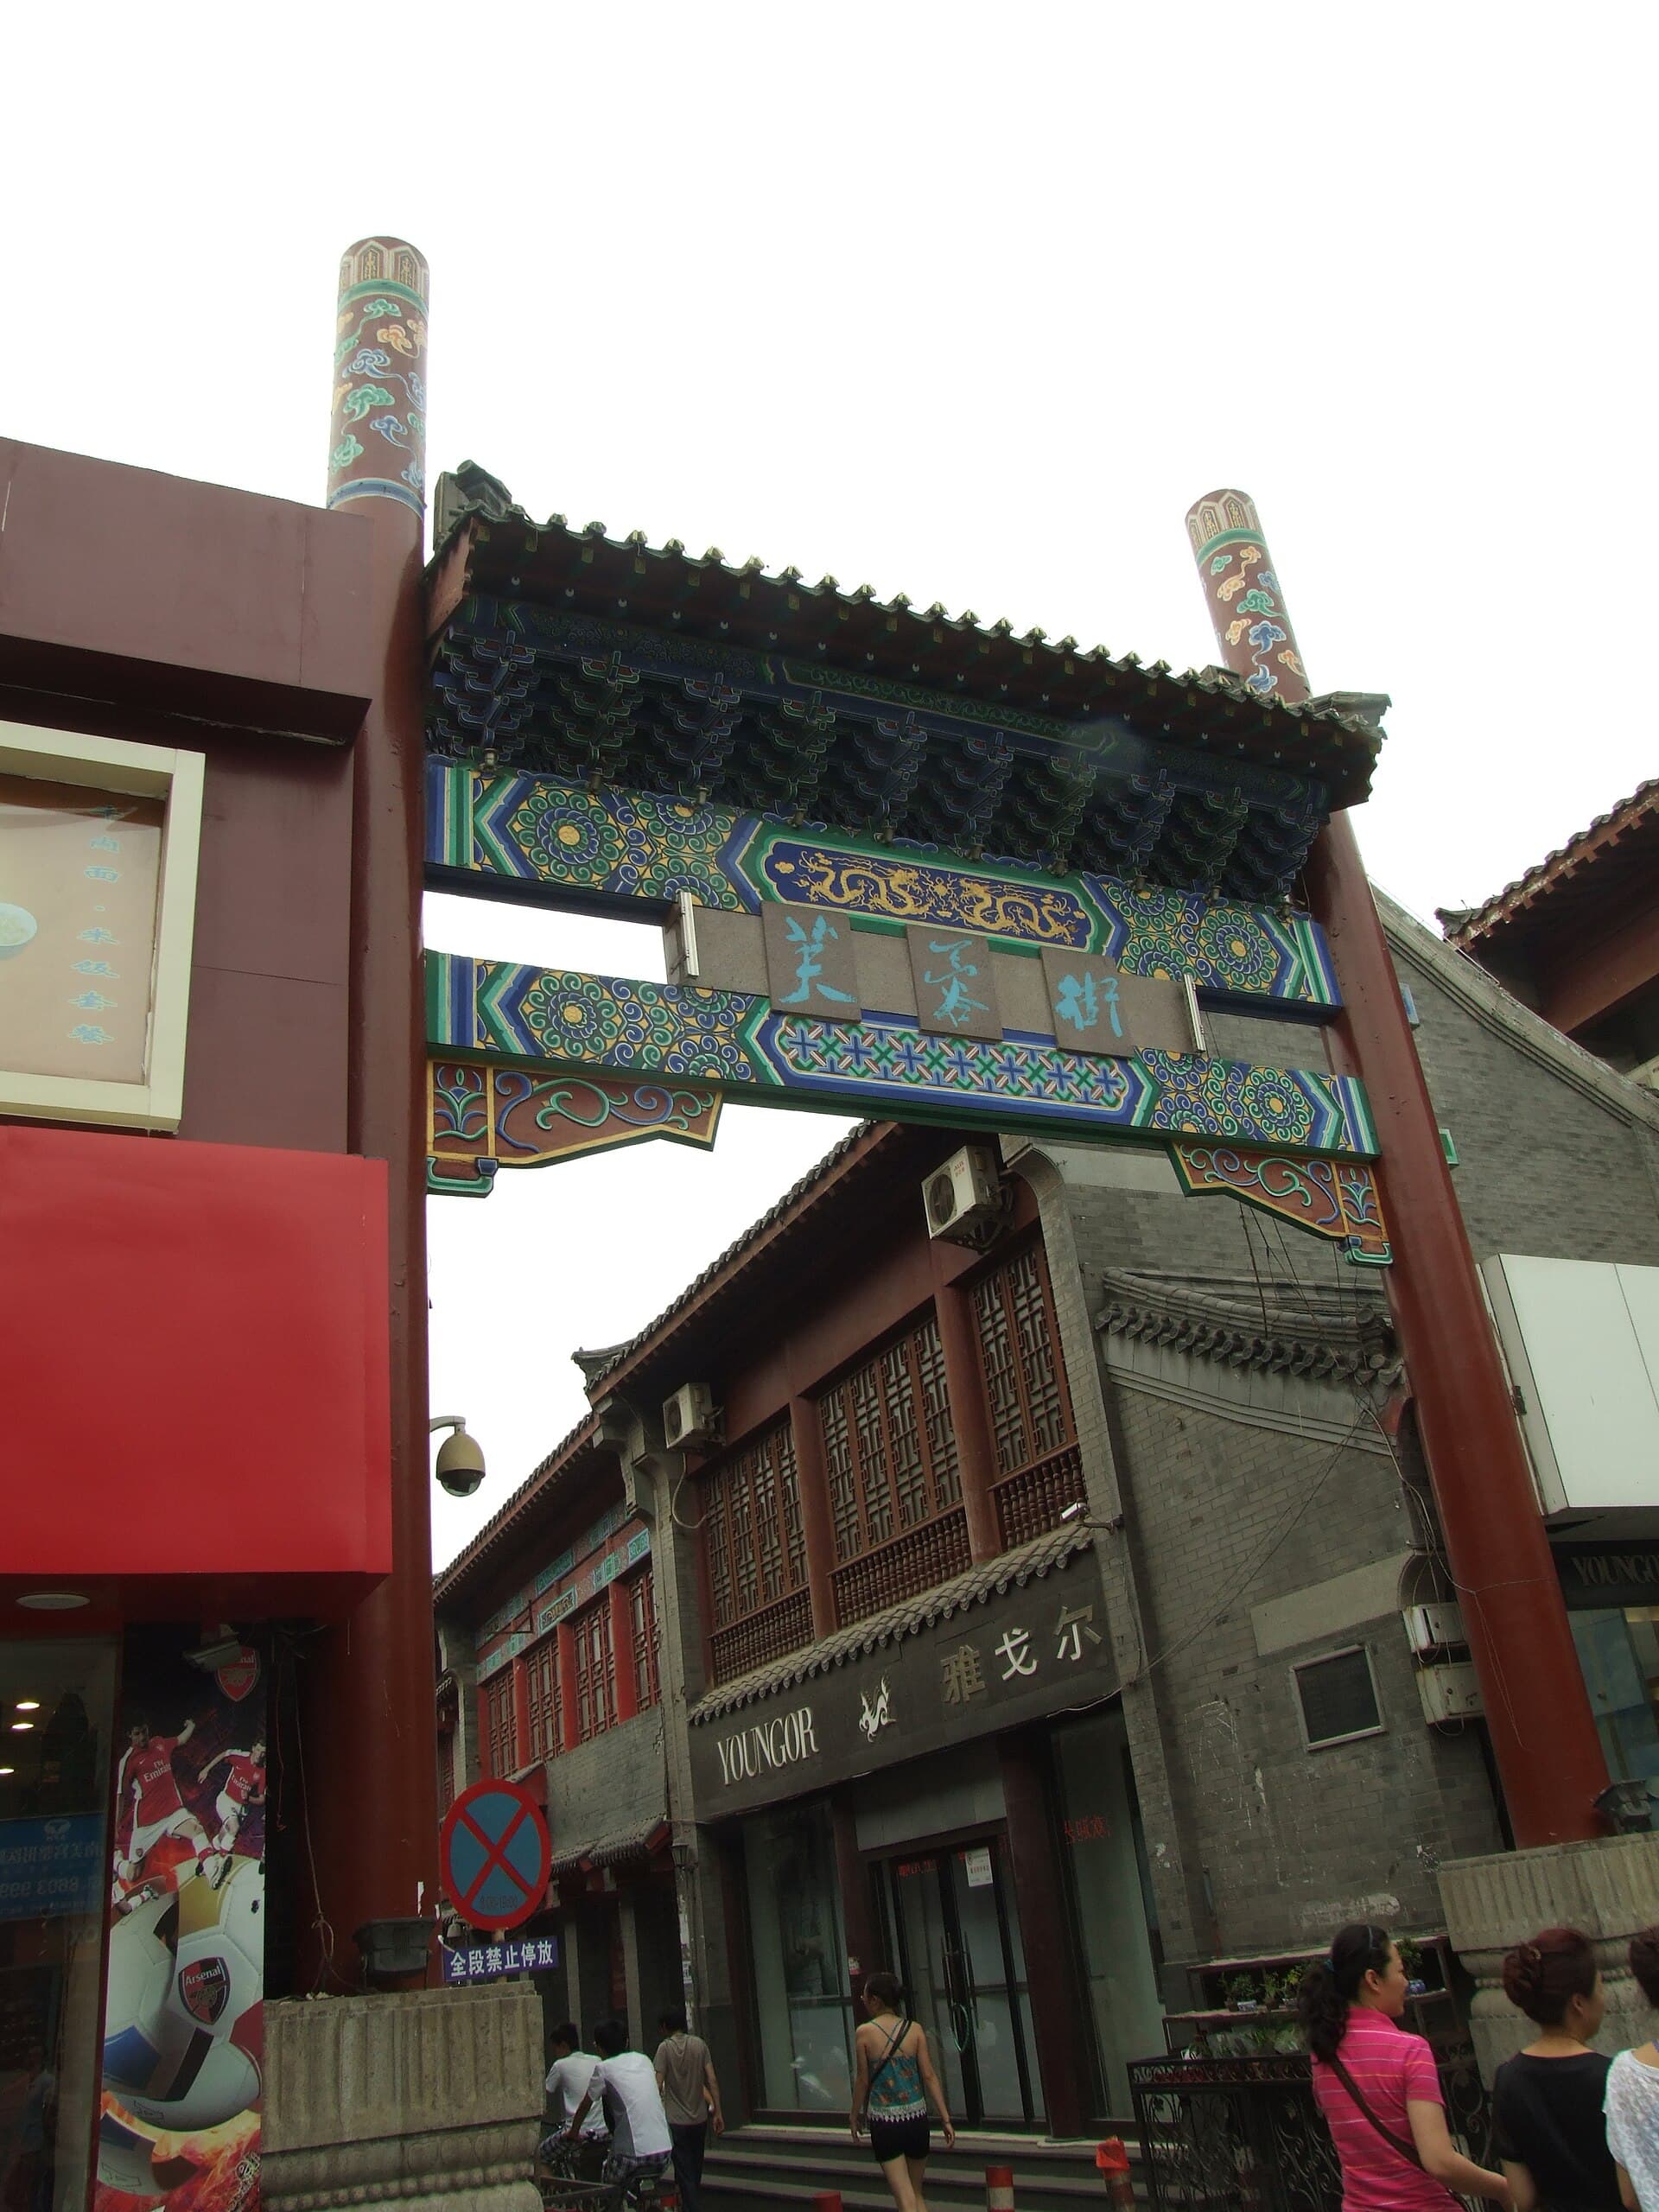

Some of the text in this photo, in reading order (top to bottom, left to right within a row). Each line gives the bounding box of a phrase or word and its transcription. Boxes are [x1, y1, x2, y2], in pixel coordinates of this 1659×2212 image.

[779, 915, 1122, 1037] 芙蓉街
[940, 1605, 1103, 1704] 雅戈尔
[716, 1707, 820, 1786] YOUNGOR
[185, 1966, 221, 1986] Arsenal
[450, 1940, 553, 1978] 全段禁止停放
